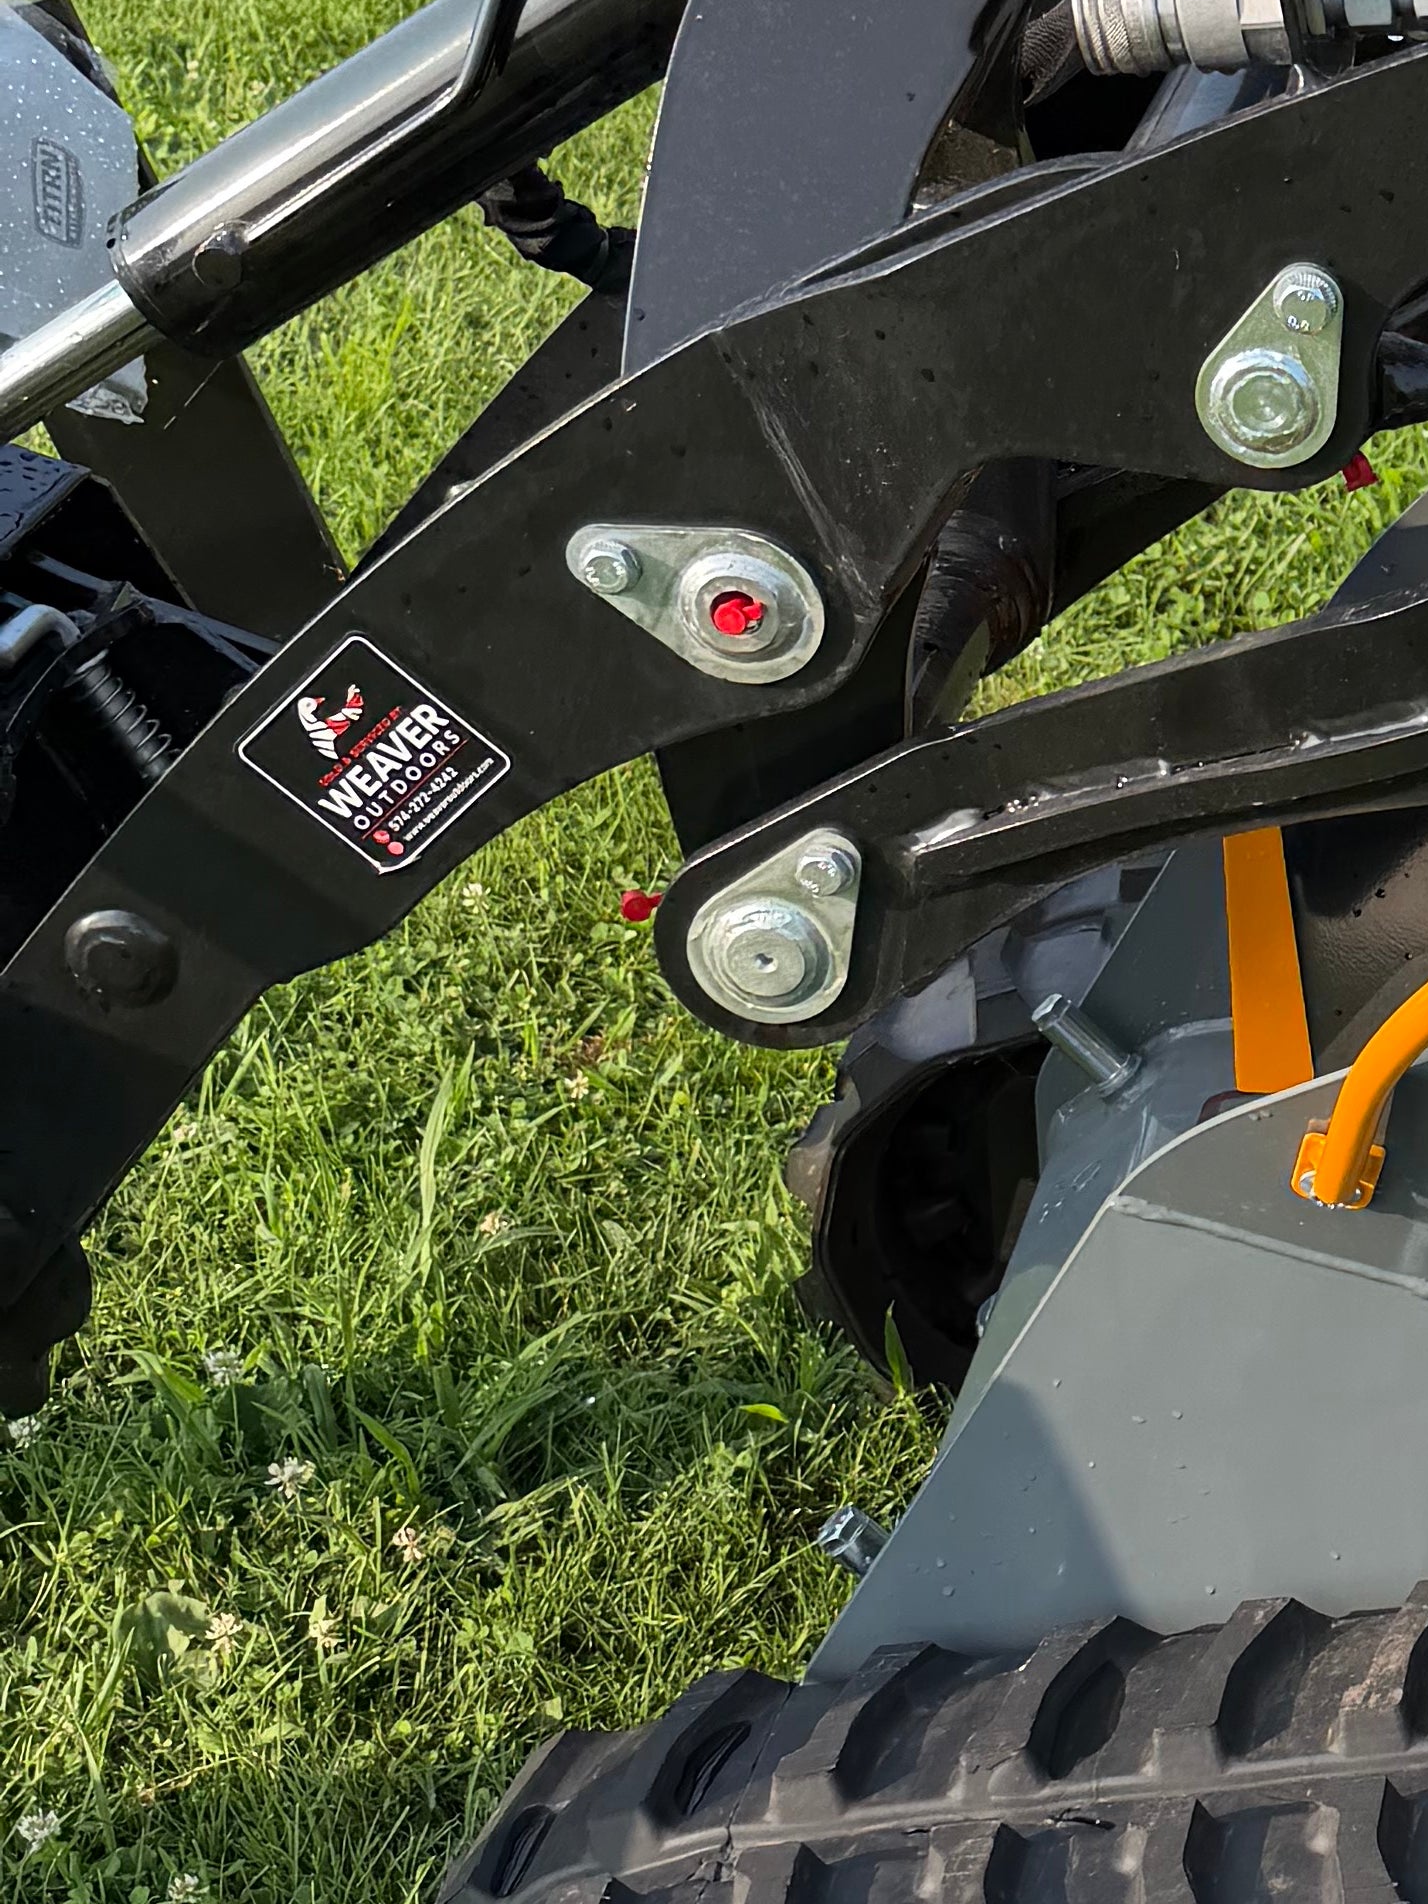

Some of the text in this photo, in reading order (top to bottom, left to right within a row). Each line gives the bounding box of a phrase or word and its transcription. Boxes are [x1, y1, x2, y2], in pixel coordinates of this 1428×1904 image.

[318, 704, 450, 819] WEAVER
[353, 729, 461, 831] OUTDOORS
[388, 766, 459, 833] 574-272-4242
